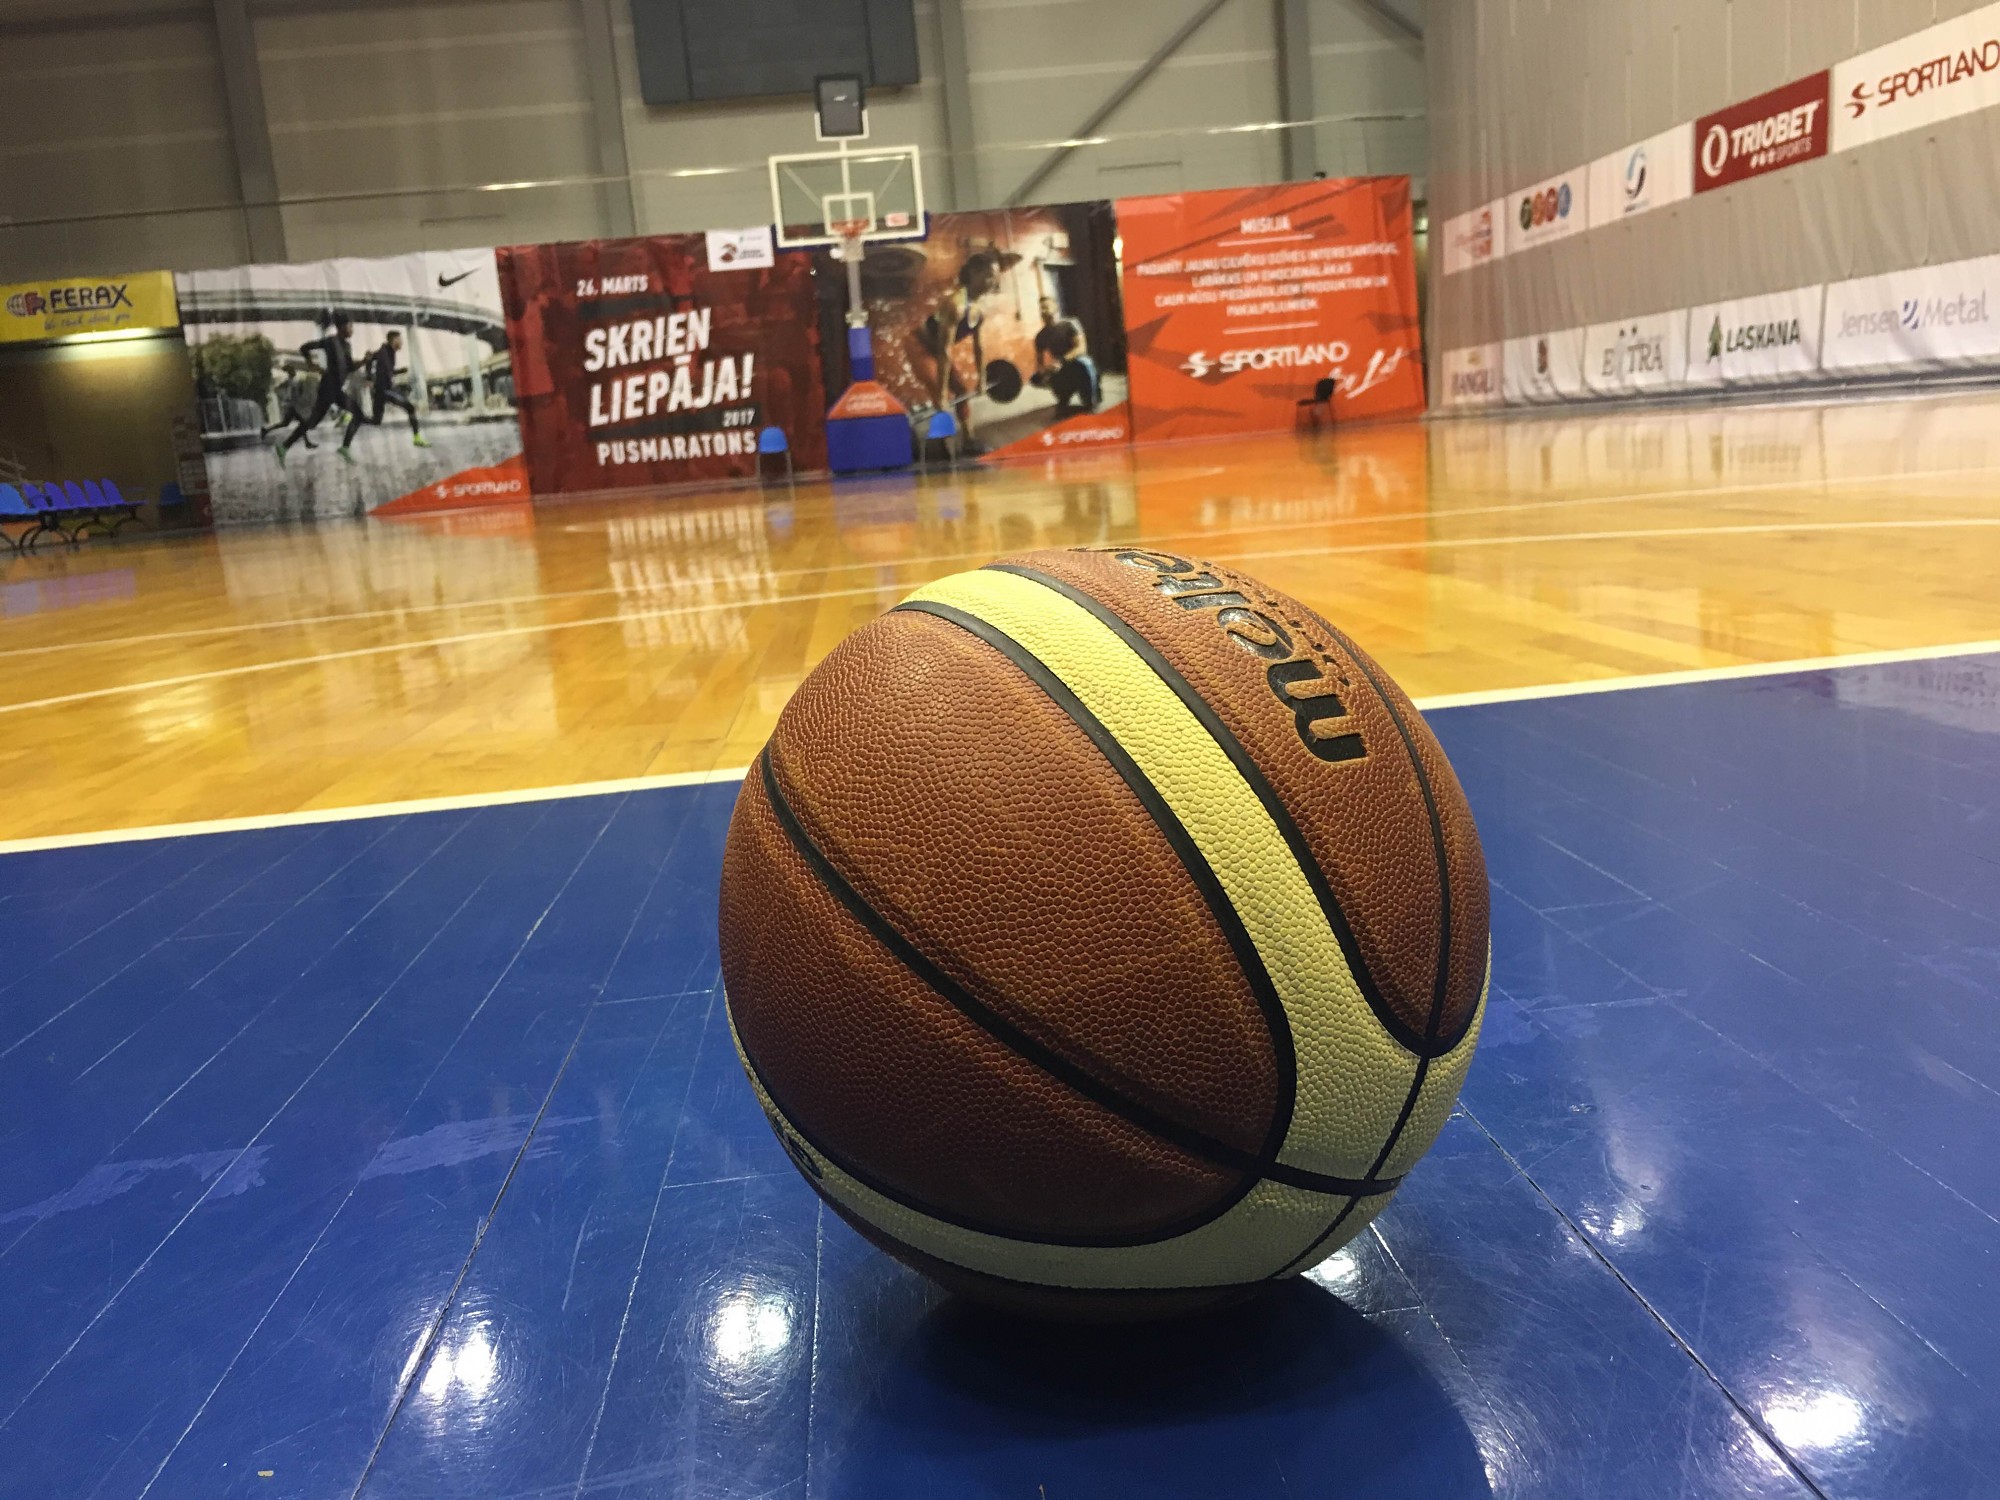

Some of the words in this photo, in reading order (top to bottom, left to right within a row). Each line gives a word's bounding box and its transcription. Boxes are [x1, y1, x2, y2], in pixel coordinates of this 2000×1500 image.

[1878, 40, 2000, 107] SPORTLAND
[1731, 99, 1823, 158] TRIOBET
[1775, 137, 1813, 162] SPORTS
[50, 284, 133, 311] FERAX
[577, 278, 600, 298] 26.
[602, 274, 649, 295] MARTS
[1837, 309, 1900, 339] Jensen
[1923, 290, 1990, 328] Metal
[583, 307, 712, 373] SKRIEN
[1726, 319, 1800, 354] LASKANA
[1218, 341, 1350, 375] SPORTLAND
[589, 352, 755, 427] LIEPĀJA!
[722, 408, 756, 430] 2017
[597, 430, 758, 467] PUSMARATONS
